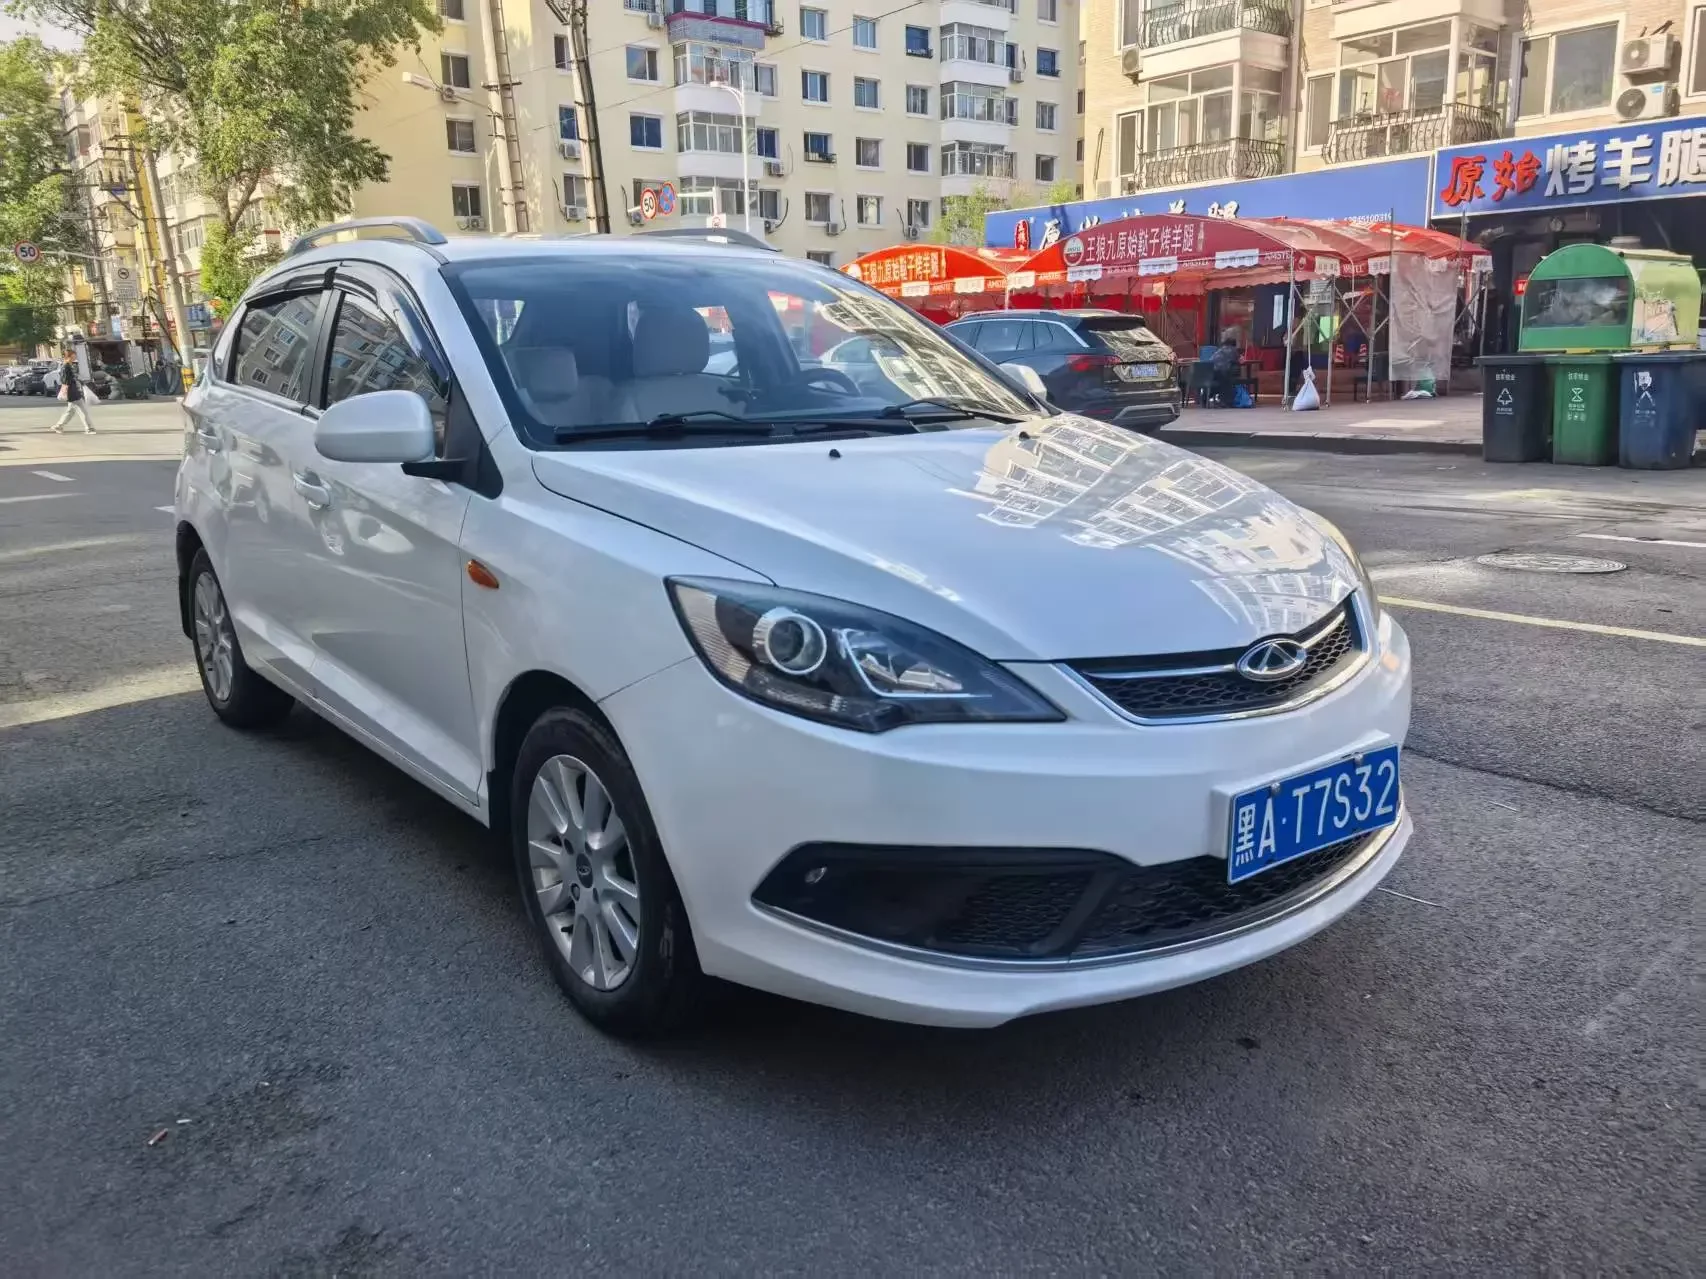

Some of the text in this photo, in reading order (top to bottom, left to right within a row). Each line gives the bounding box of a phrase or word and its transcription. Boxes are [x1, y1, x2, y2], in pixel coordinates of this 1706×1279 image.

[1440, 128, 1706, 207] 原始烤羊腿
[643, 196, 655, 213] 50
[20, 246, 36, 258] 50
